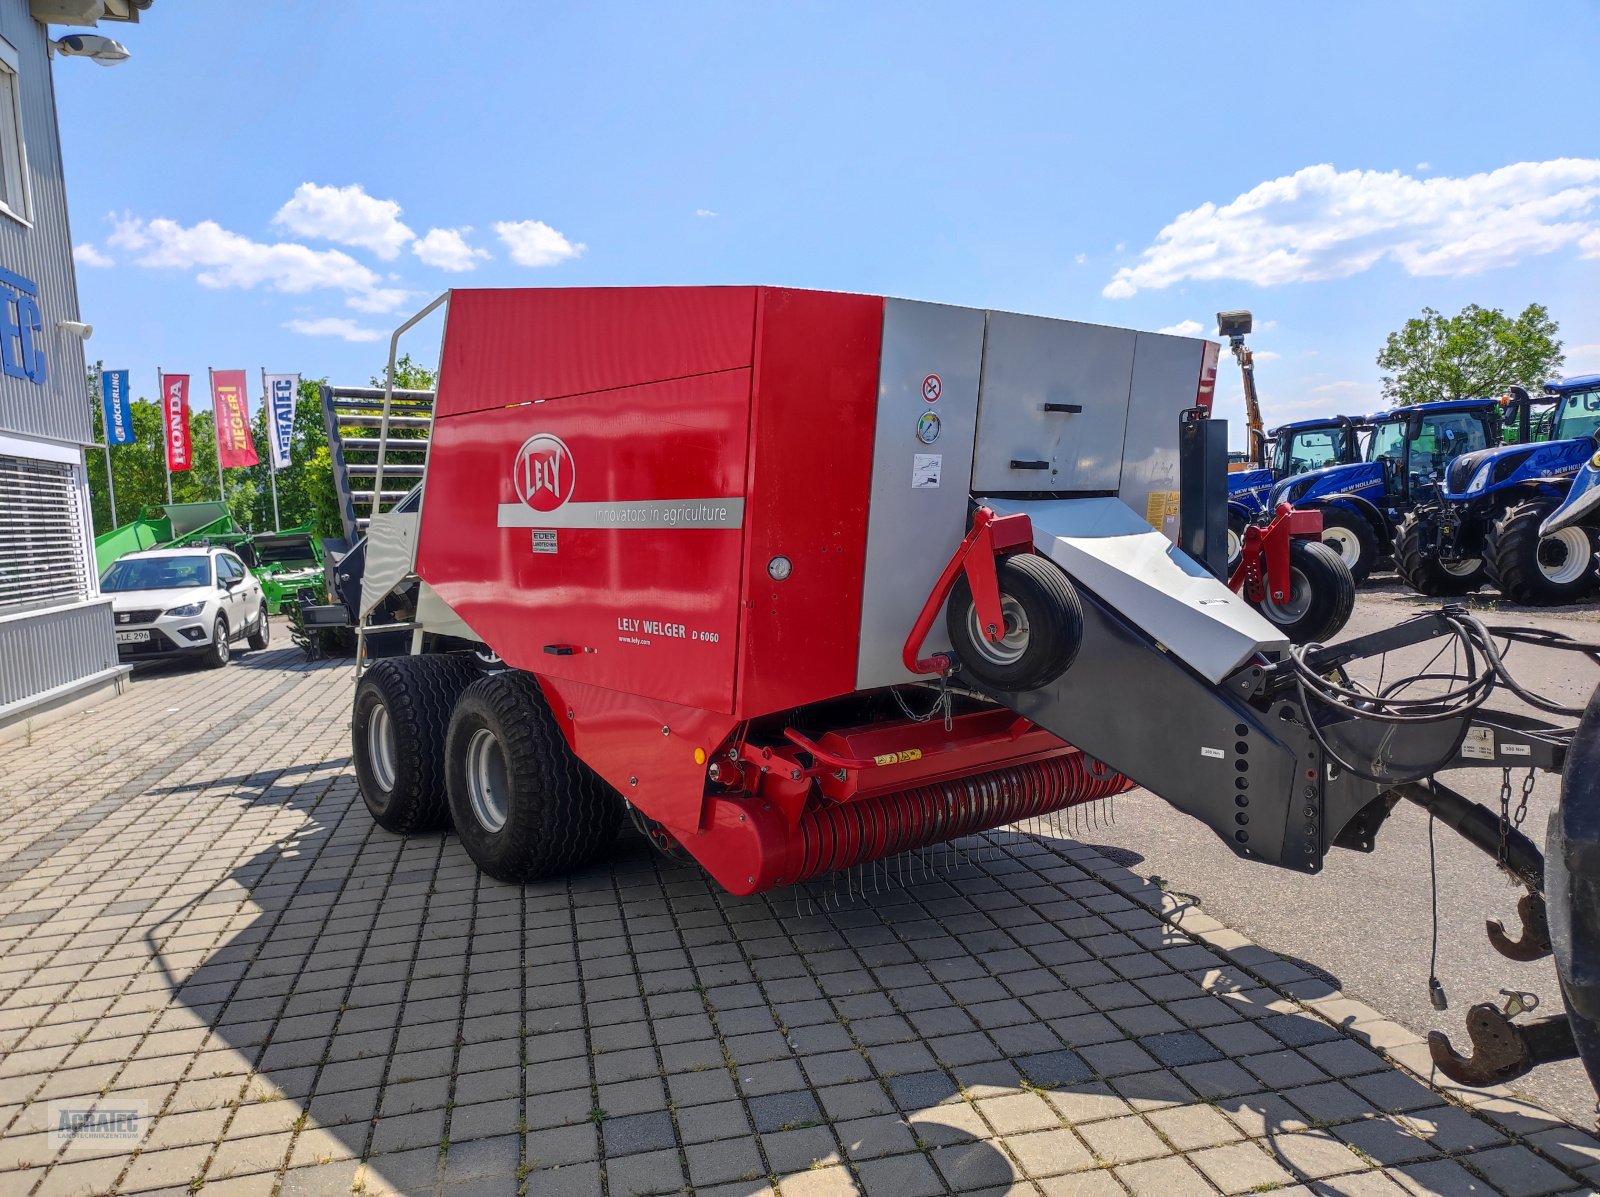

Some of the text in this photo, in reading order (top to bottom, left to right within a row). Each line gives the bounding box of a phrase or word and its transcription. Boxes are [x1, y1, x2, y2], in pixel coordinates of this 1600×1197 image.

[170, 379, 186, 465] HONDA
[226, 394, 247, 450] ZIEGLER
[524, 449, 561, 501] LELY
[1555, 466, 1569, 474] NEW
[1234, 487, 1248, 495] NEW
[1340, 477, 1382, 493] NEW HOLLAND
[595, 503, 727, 525] innovators in agriculture
[133, 631, 149, 640] 296
[617, 617, 719, 643] LELY WELGER D 6060
[618, 635, 651, 646] www.lely.com
